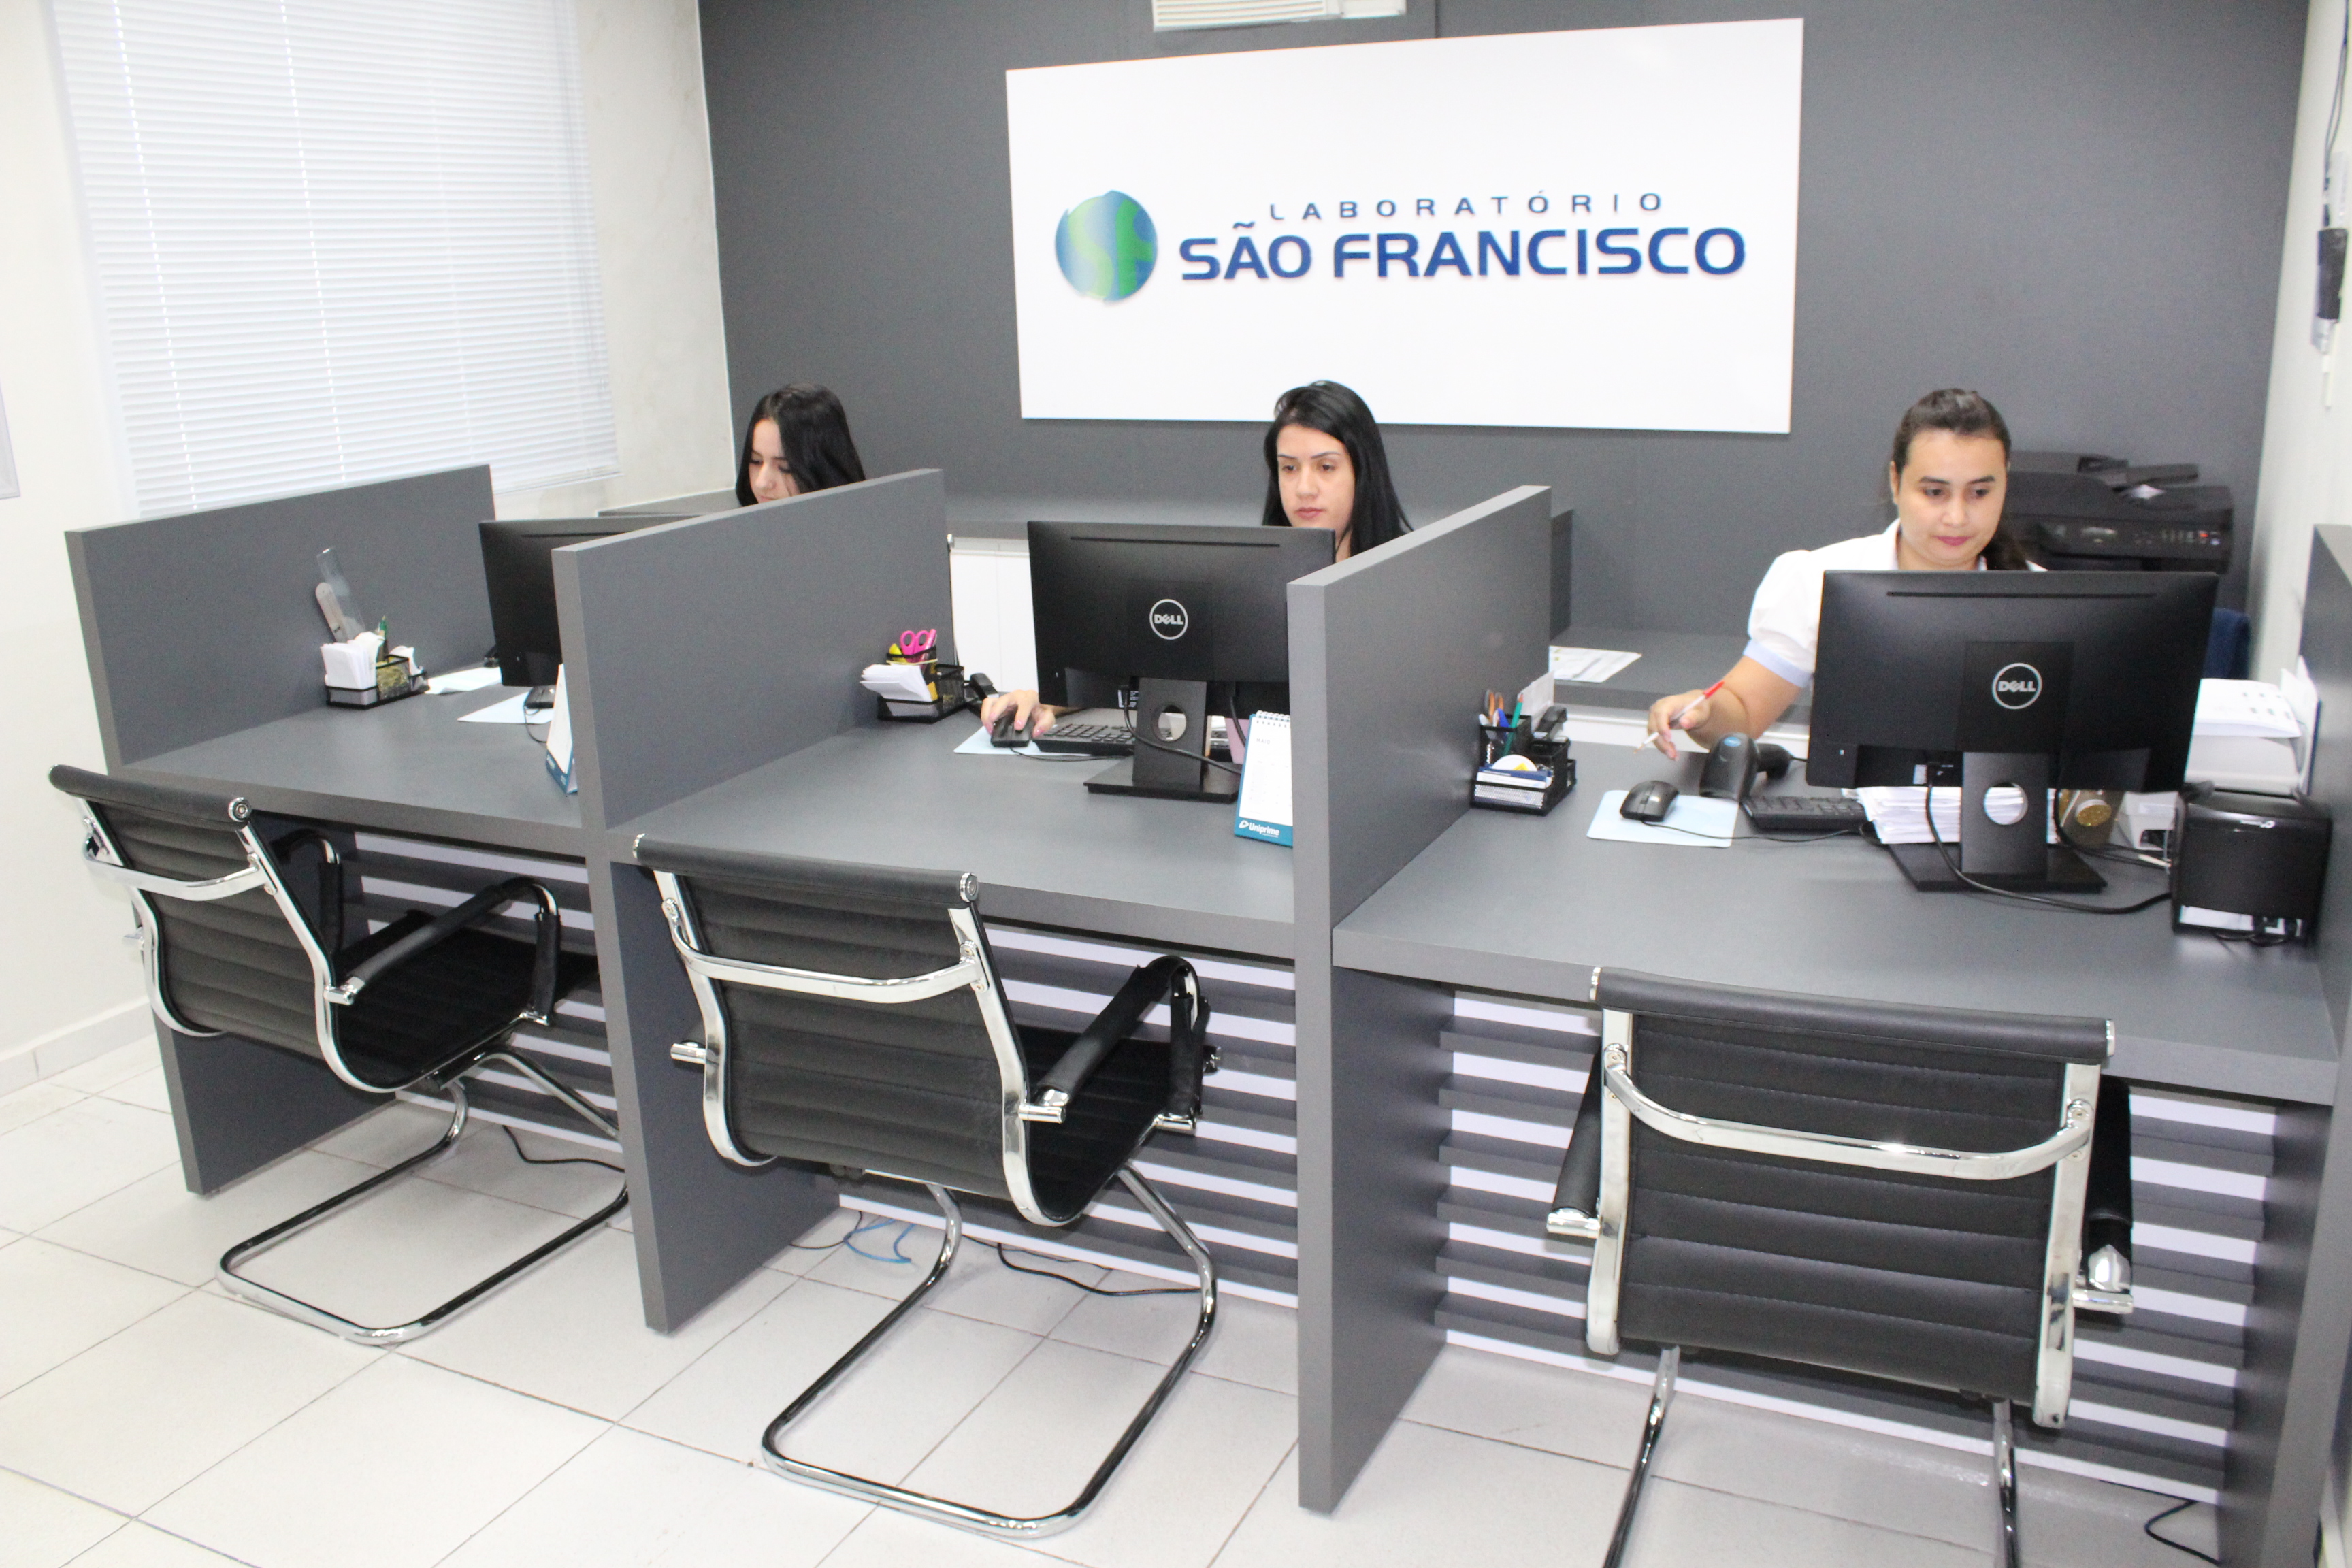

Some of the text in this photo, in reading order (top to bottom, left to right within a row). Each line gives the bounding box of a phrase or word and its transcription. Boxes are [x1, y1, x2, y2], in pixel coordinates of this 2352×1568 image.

[1271, 189, 1661, 220] LABORATÓRIO
[1179, 222, 1746, 280] SÃO FRANCISCO
[1154, 614, 1184, 625] DELL
[1998, 681, 2036, 692] DELL
[1249, 822, 1279, 836] Uniprime
